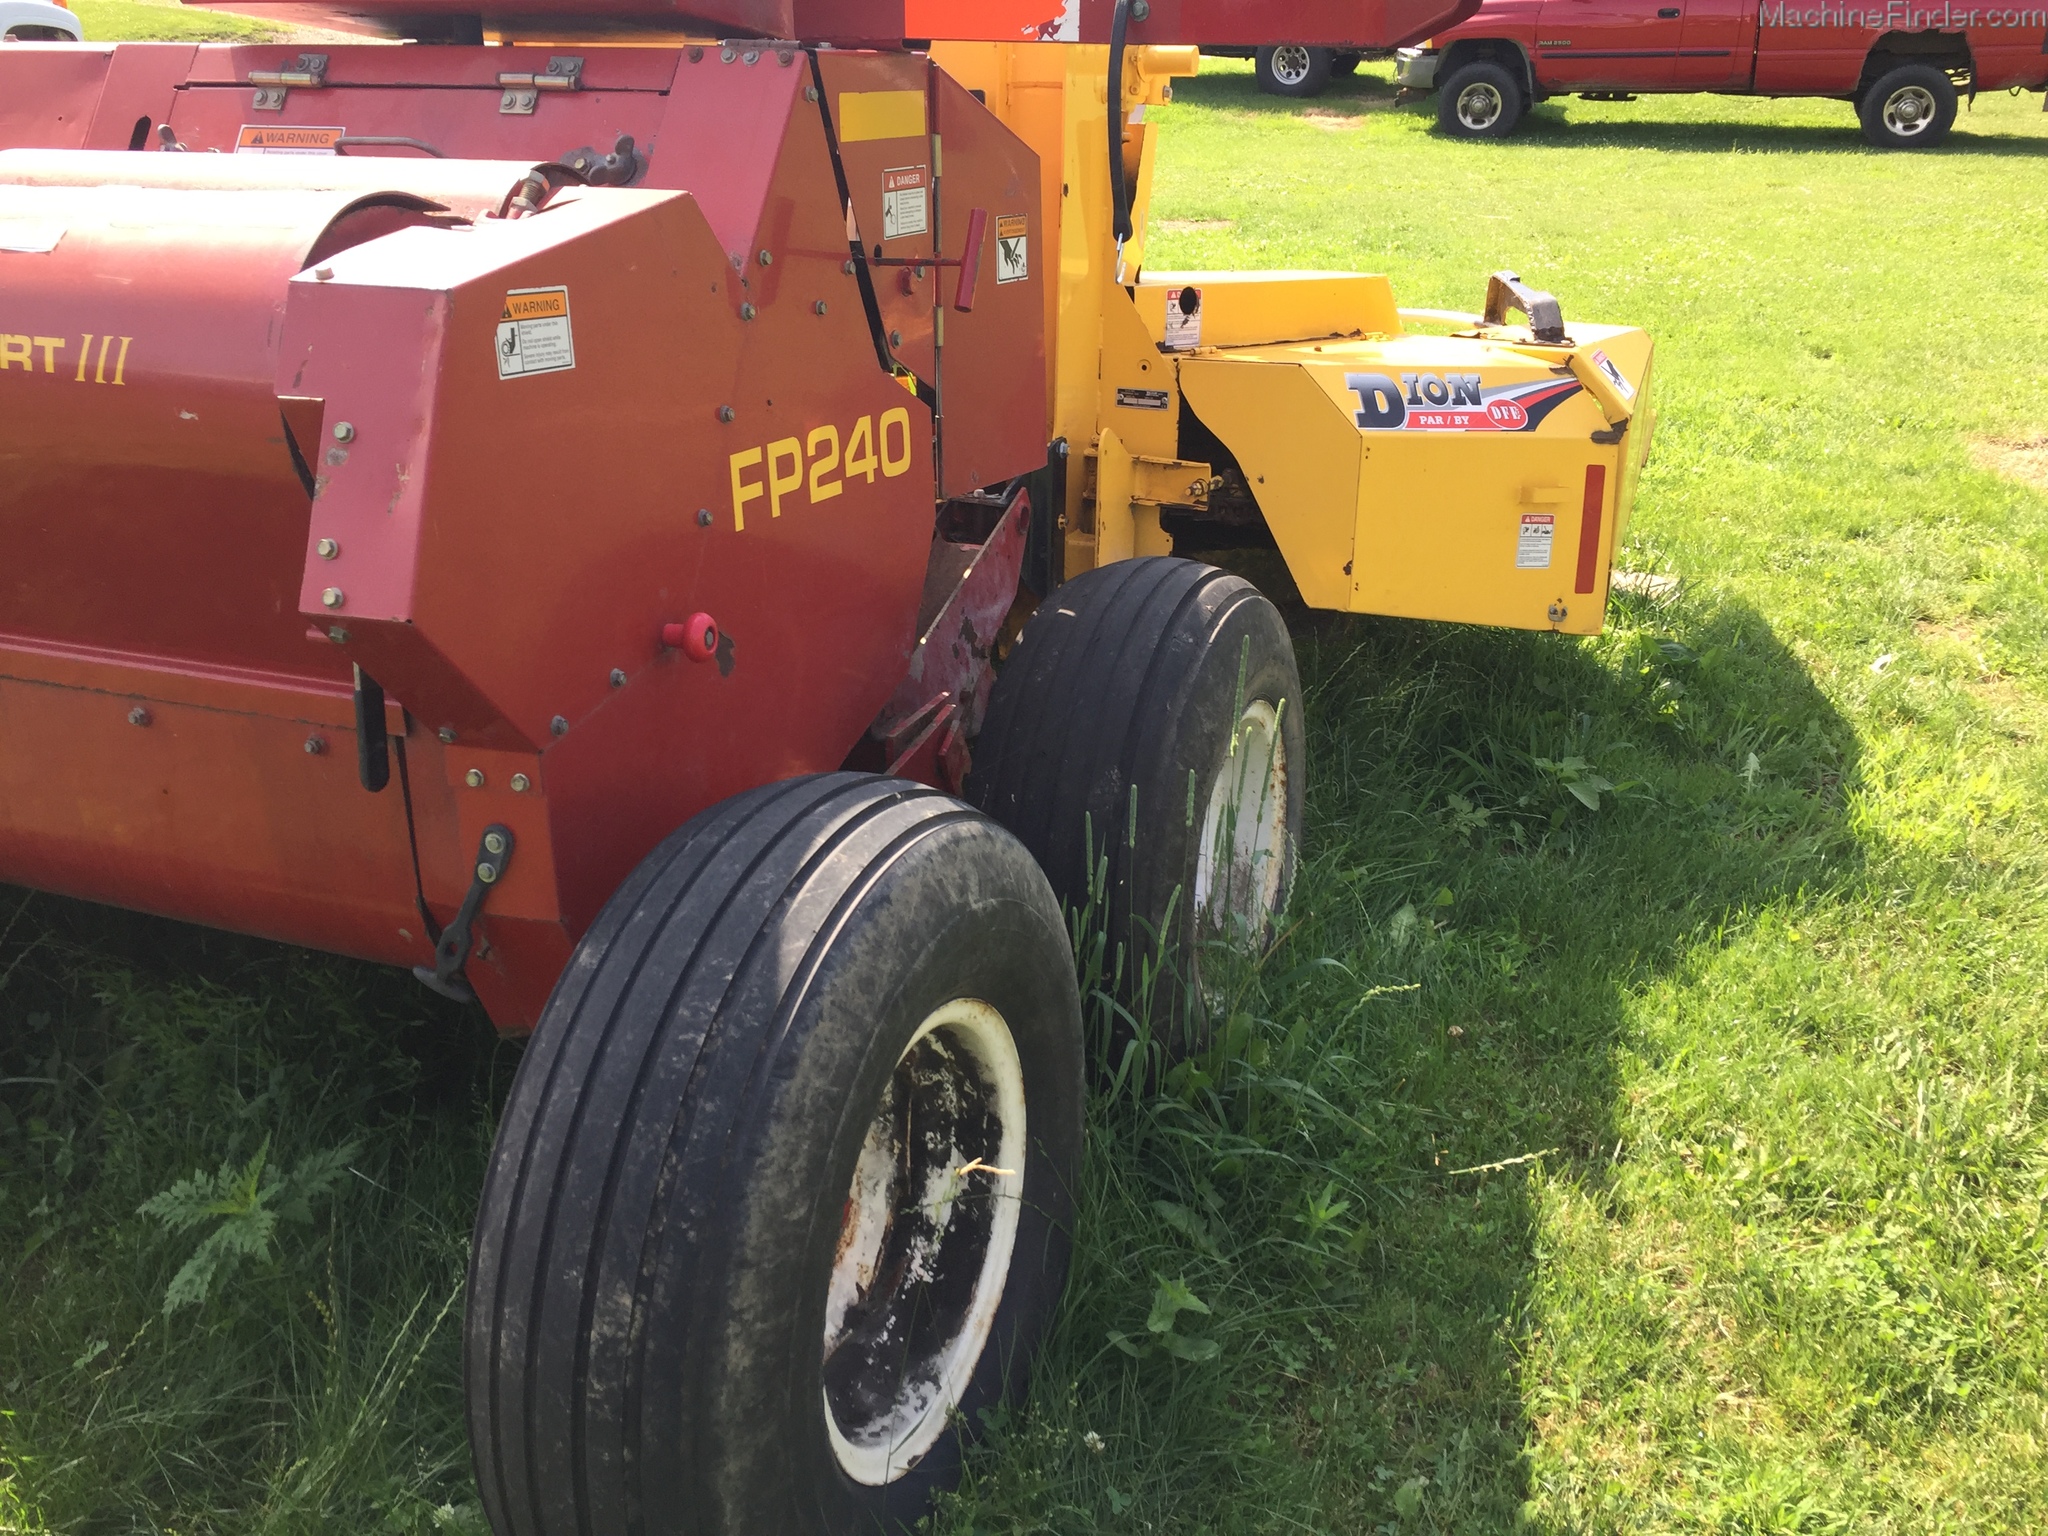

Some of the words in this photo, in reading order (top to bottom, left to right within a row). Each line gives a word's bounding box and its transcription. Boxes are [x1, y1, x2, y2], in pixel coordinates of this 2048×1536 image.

[266, 132, 330, 144] WARNING
[896, 173, 920, 186] DANGER
[512, 299, 560, 314] WARNING
[74, 334, 133, 385] III
[1347, 373, 1482, 428] DION
[1419, 415, 1443, 425] PAR
[1446, 415, 1451, 425] /
[1454, 415, 1469, 425] BY
[1490, 406, 1522, 420] DFE
[729, 407, 911, 532] FP240
